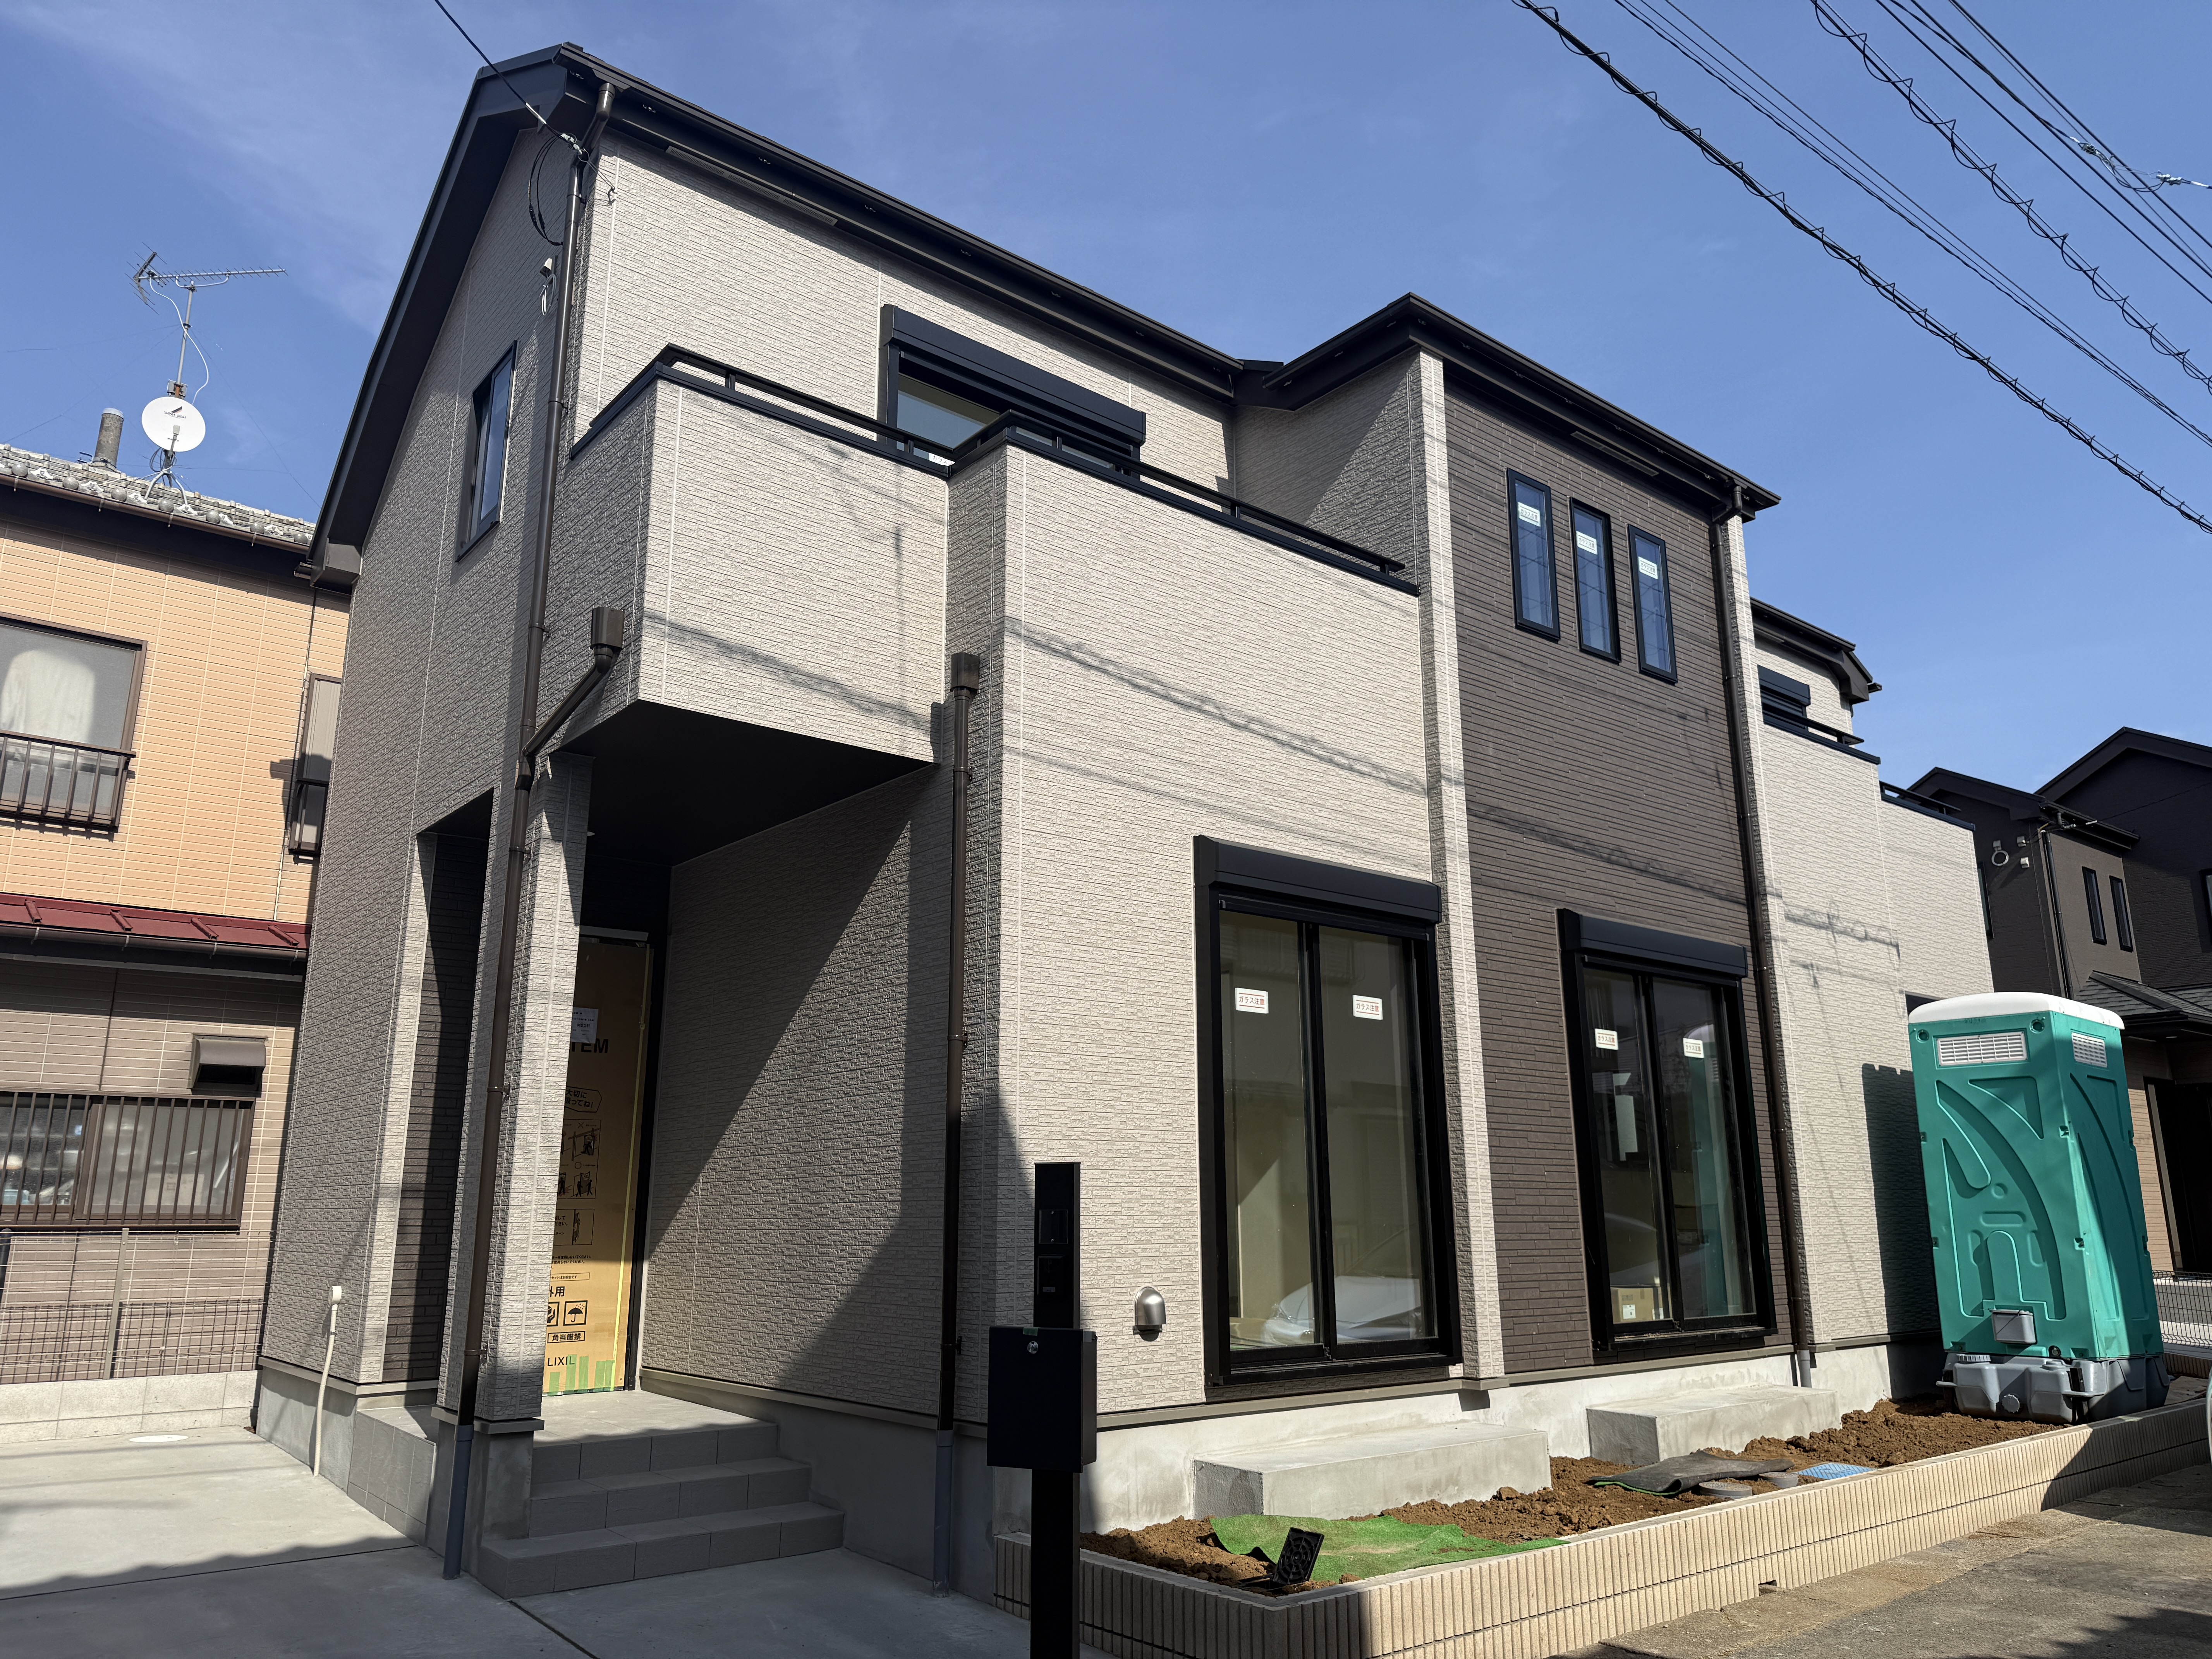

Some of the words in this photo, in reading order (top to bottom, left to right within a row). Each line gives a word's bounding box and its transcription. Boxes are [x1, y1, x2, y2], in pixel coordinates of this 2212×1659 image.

[552, 1333, 581, 1341] 角当厳禁
[548, 1356, 575, 1366] LIXIL
